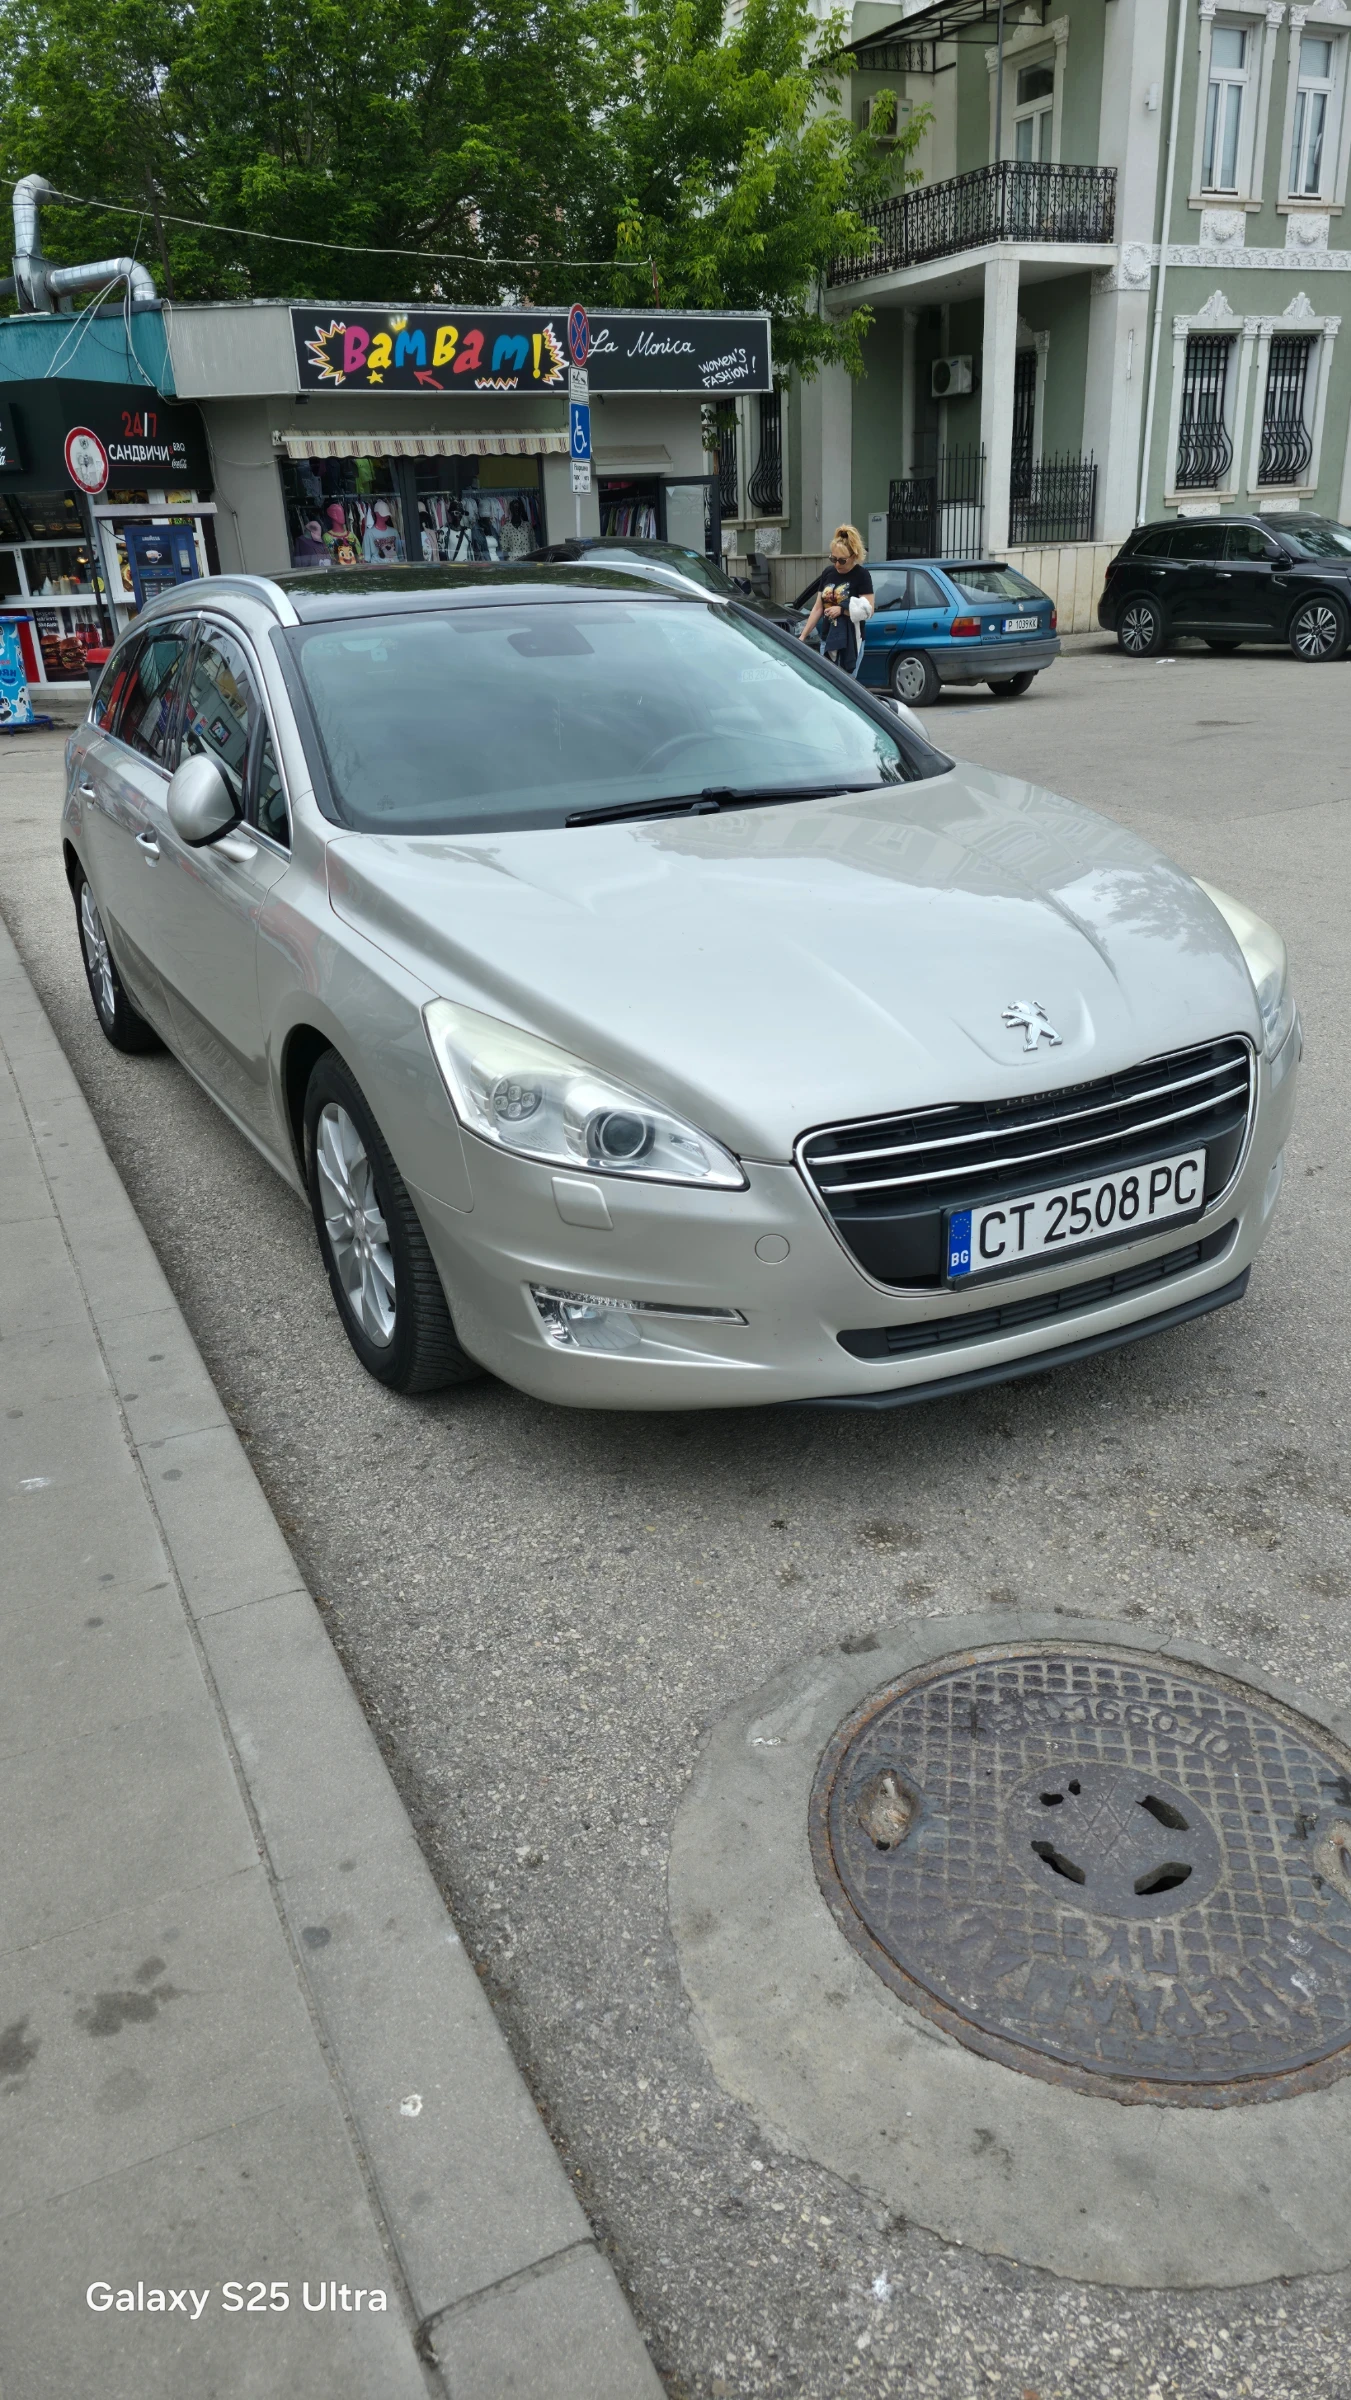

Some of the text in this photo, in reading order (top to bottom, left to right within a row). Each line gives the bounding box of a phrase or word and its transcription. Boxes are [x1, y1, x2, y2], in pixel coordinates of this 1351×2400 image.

[587, 329, 696, 358] La Monica
[108, 443, 170, 462] САНДВИЧИ
[951, 1159, 1199, 1267] BG CT 2508 PC
